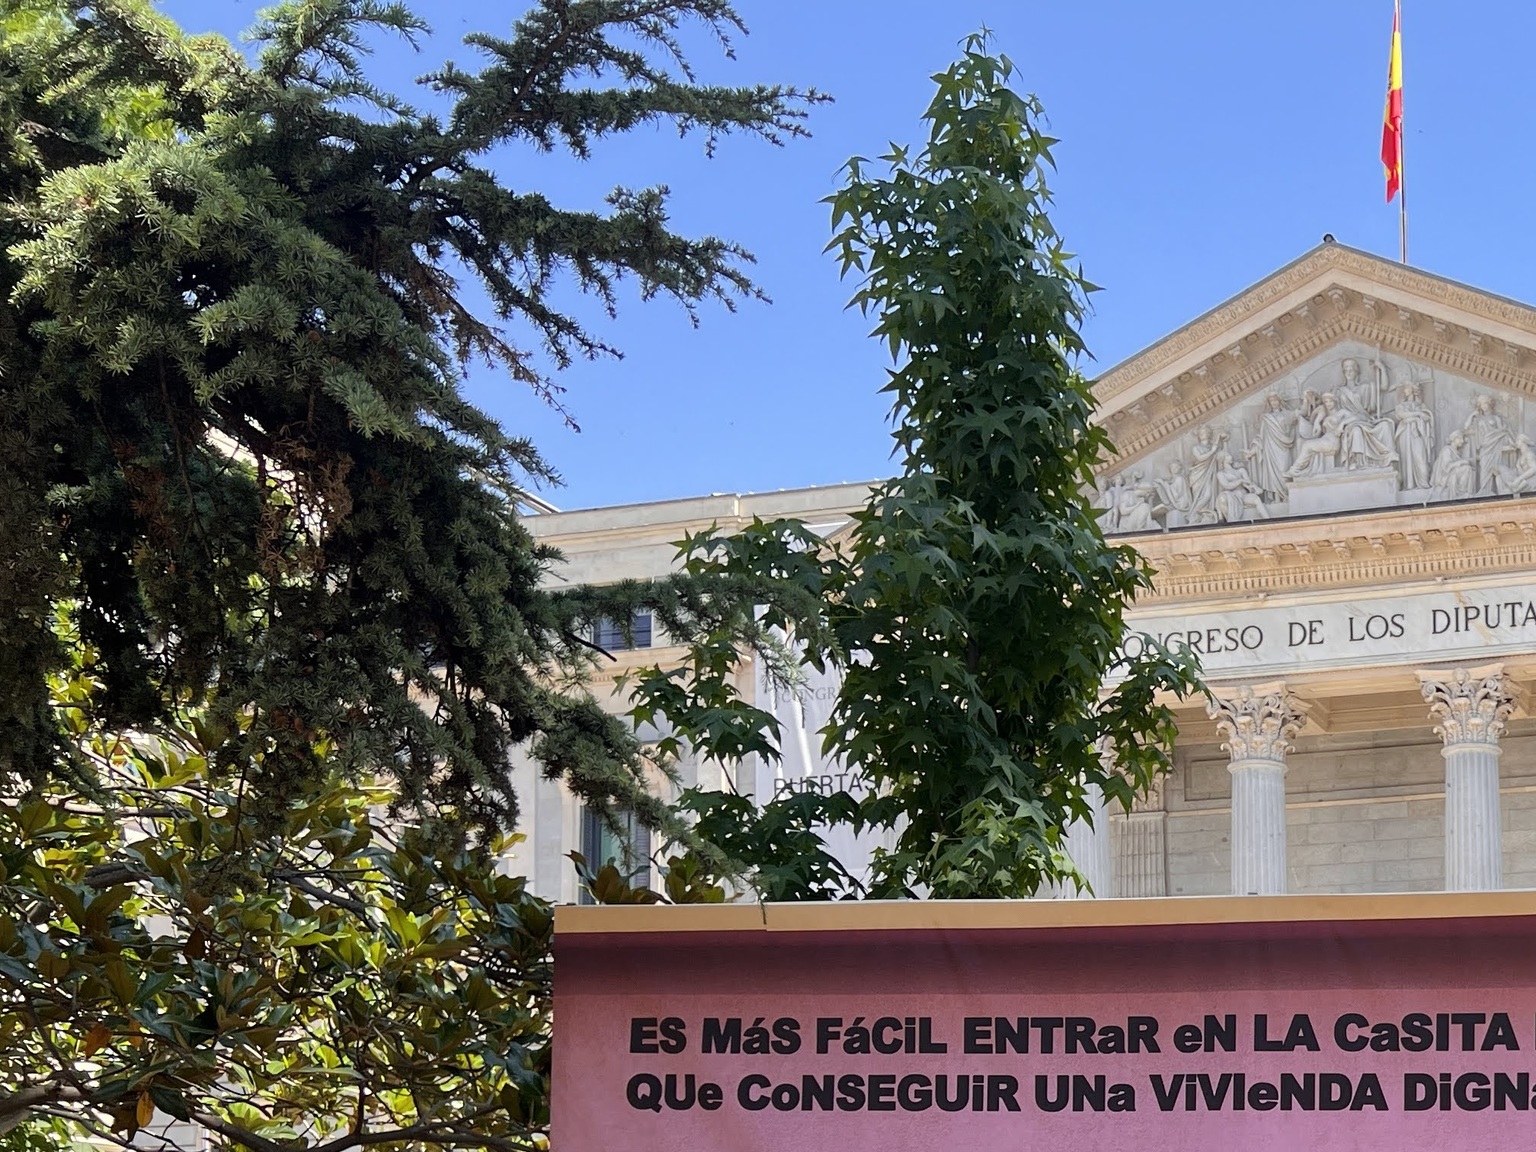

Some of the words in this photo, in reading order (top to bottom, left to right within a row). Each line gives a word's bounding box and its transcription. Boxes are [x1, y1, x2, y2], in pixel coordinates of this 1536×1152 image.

[1122, 625, 1264, 659] OGRESO
[1288, 619, 1325, 648] DE
[1348, 613, 1406, 643] LOS
[629, 1016, 687, 1055] ES
[701, 1016, 802, 1055] MáS
[816, 1016, 948, 1055] FáCiL
[963, 1014, 1162, 1055] ENTRaR
[1173, 1014, 1237, 1054] eN
[1253, 1013, 1321, 1052] LA
[1333, 1012, 1521, 1053] CaSITA
[626, 1073, 724, 1114] QUe
[737, 1073, 1022, 1113] CoNSEGUiR
[1034, 1073, 1137, 1113] UNa
[1148, 1072, 1390, 1113] ViVIeNDA
